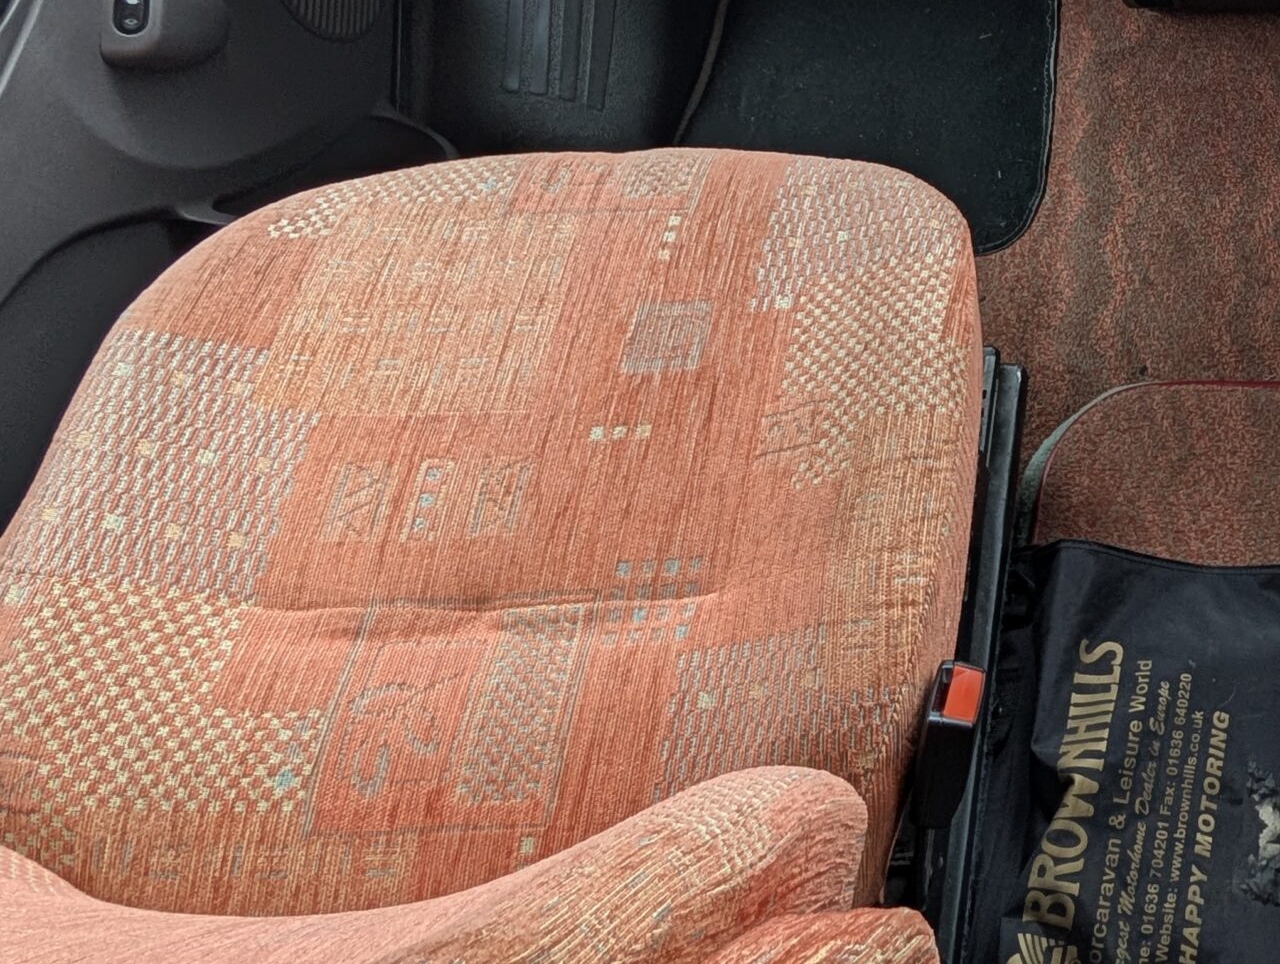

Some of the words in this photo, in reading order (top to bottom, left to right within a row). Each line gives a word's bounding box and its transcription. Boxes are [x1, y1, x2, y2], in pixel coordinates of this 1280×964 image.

[1113, 720, 1143, 804] Leisure
[1128, 660, 1152, 713] World
[1174, 673, 1192, 725] 640220
[1020, 638, 1124, 930] BROWNHILLS
[1166, 730, 1184, 775] 01636
[1117, 820, 1149, 915] Motorhome
[1135, 761, 1157, 815] Dealer
[1149, 681, 1172, 735] Europe
[1160, 711, 1204, 882] www.brownhills.co.uk
[1160, 781, 1175, 815] Fax:
[1149, 822, 1169, 878] 704201
[1179, 864, 1207, 964] HAPPY
[1194, 711, 1229, 858] MOTORING
[1141, 884, 1160, 934] 01636
[1155, 888, 1178, 962] Website:
